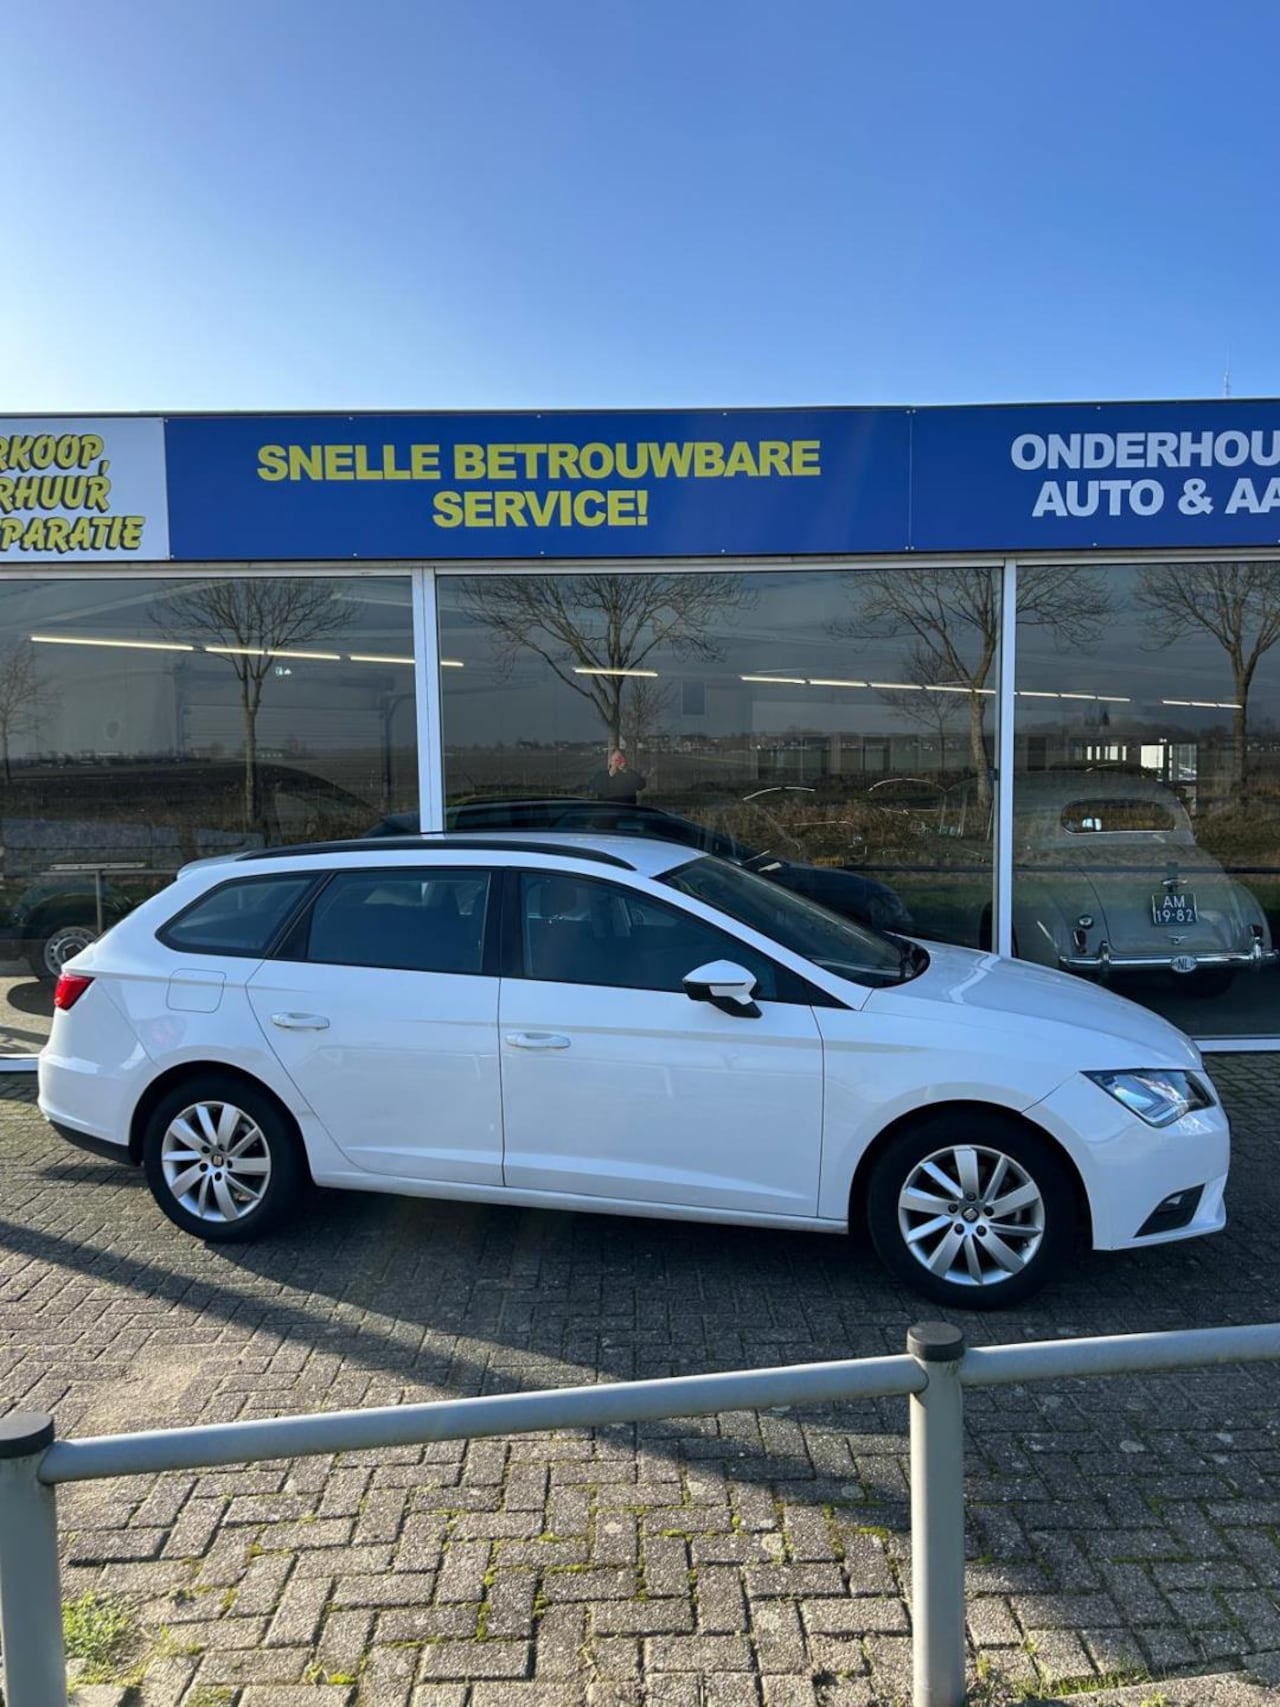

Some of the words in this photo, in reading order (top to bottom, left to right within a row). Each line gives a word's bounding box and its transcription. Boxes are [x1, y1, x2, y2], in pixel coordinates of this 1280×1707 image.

[257, 444, 440, 481] SNELLE
[454, 440, 821, 480] BETROUWBARE
[1011, 430, 1280, 470] ONDERHOU
[433, 490, 648, 529] SERVICE!
[1032, 479, 1165, 517] AUTO
[1178, 478, 1214, 515] &
[1156, 909, 1193, 922] 19-82
[1163, 895, 1185, 908] AM
